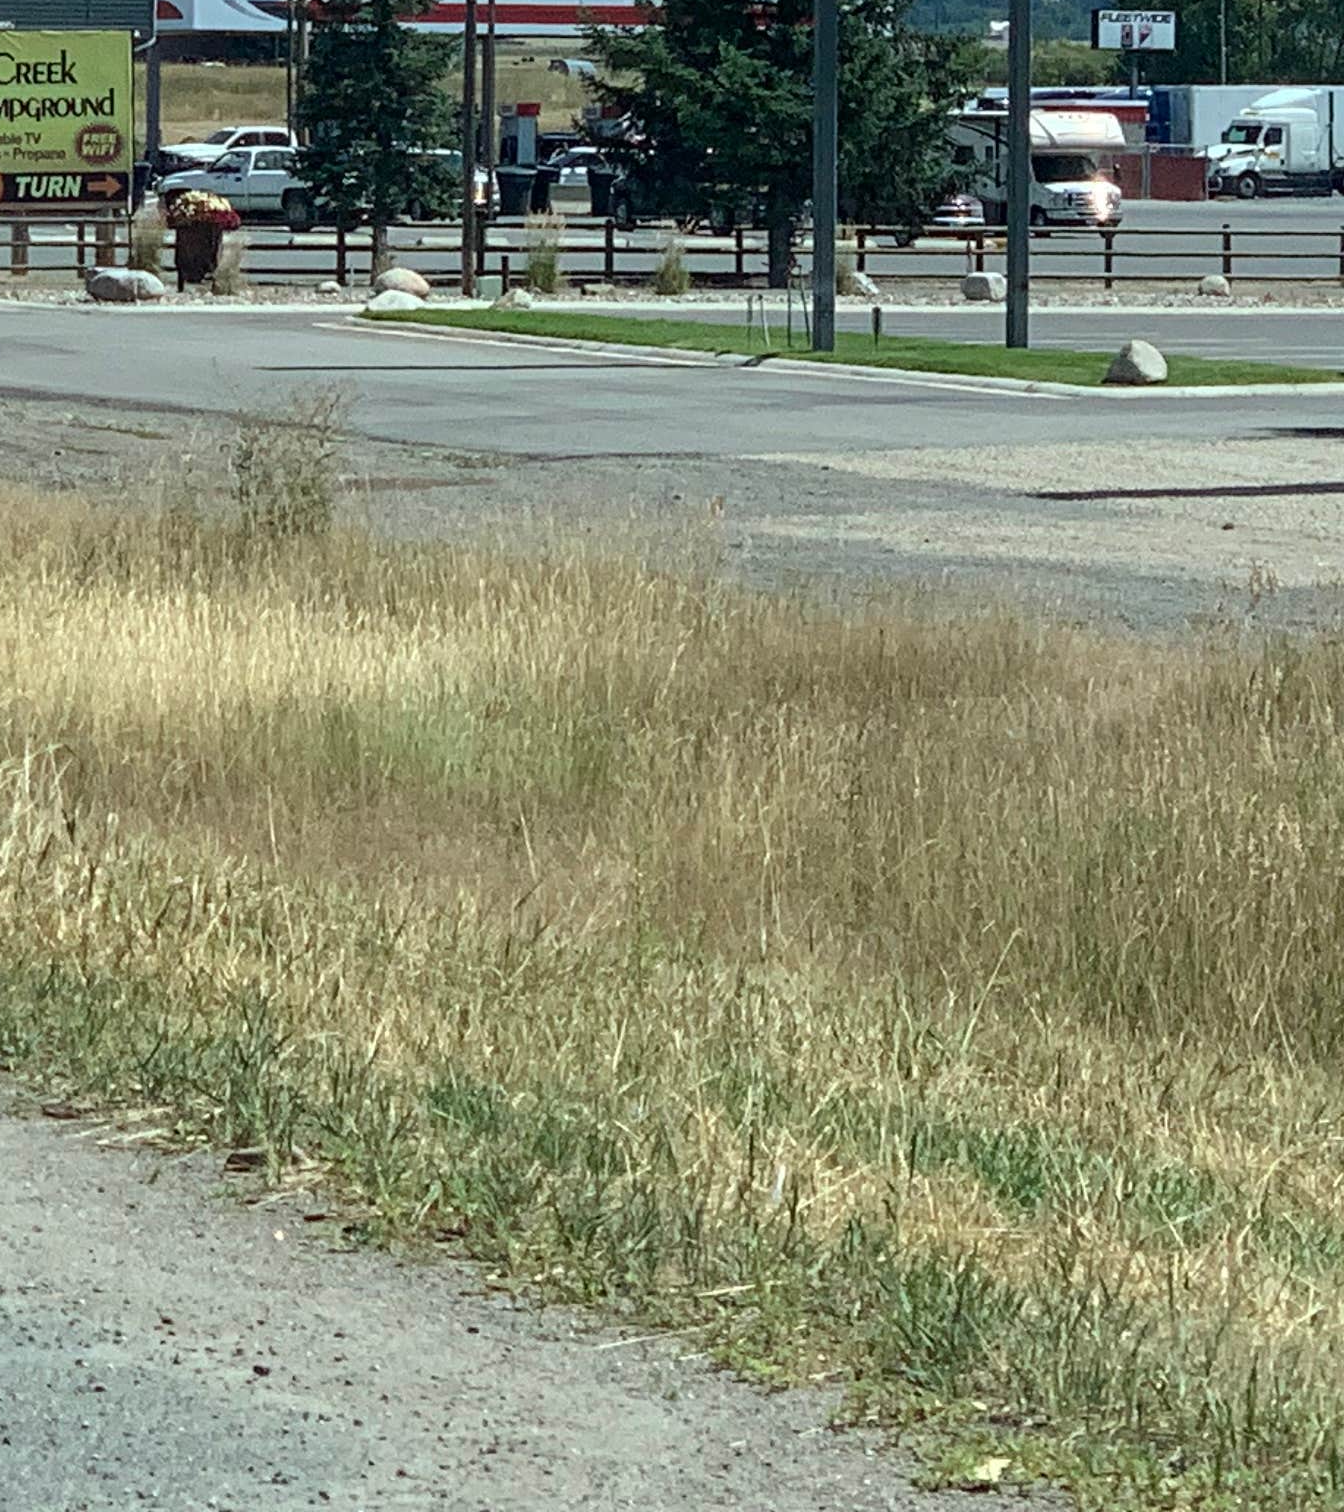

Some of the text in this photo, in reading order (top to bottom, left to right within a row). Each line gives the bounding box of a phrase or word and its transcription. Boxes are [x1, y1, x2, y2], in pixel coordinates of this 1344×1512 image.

[24, 132, 42, 144] TV
[12, 148, 67, 162] Propane
[15, 175, 82, 198] TURN
